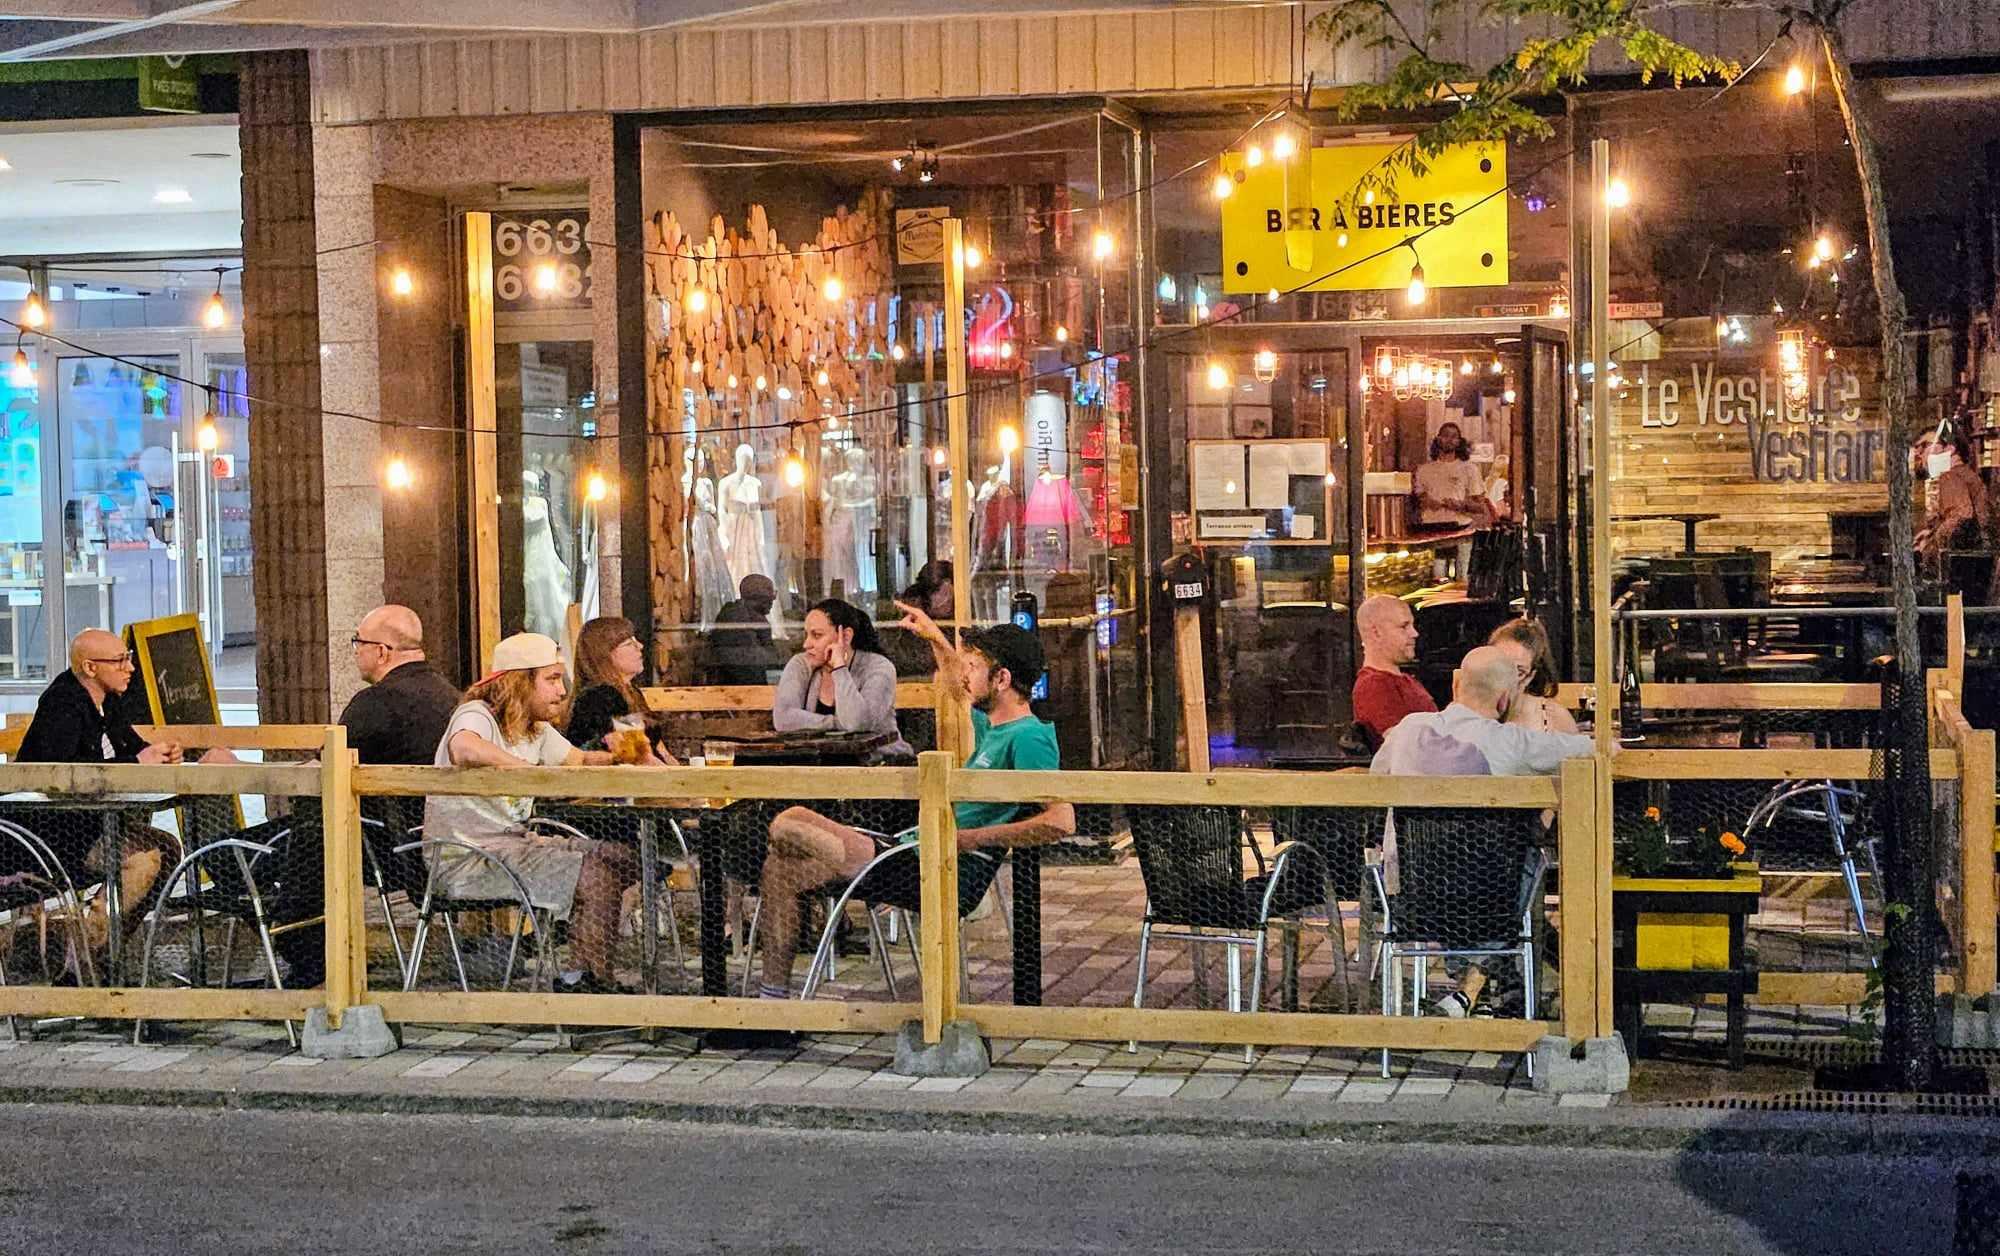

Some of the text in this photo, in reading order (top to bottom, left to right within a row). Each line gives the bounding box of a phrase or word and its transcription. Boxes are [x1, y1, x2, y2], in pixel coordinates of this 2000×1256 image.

[496, 218, 592, 257] 663
[1642, 364, 1680, 427] Le
[1176, 584, 1201, 597] 6634
